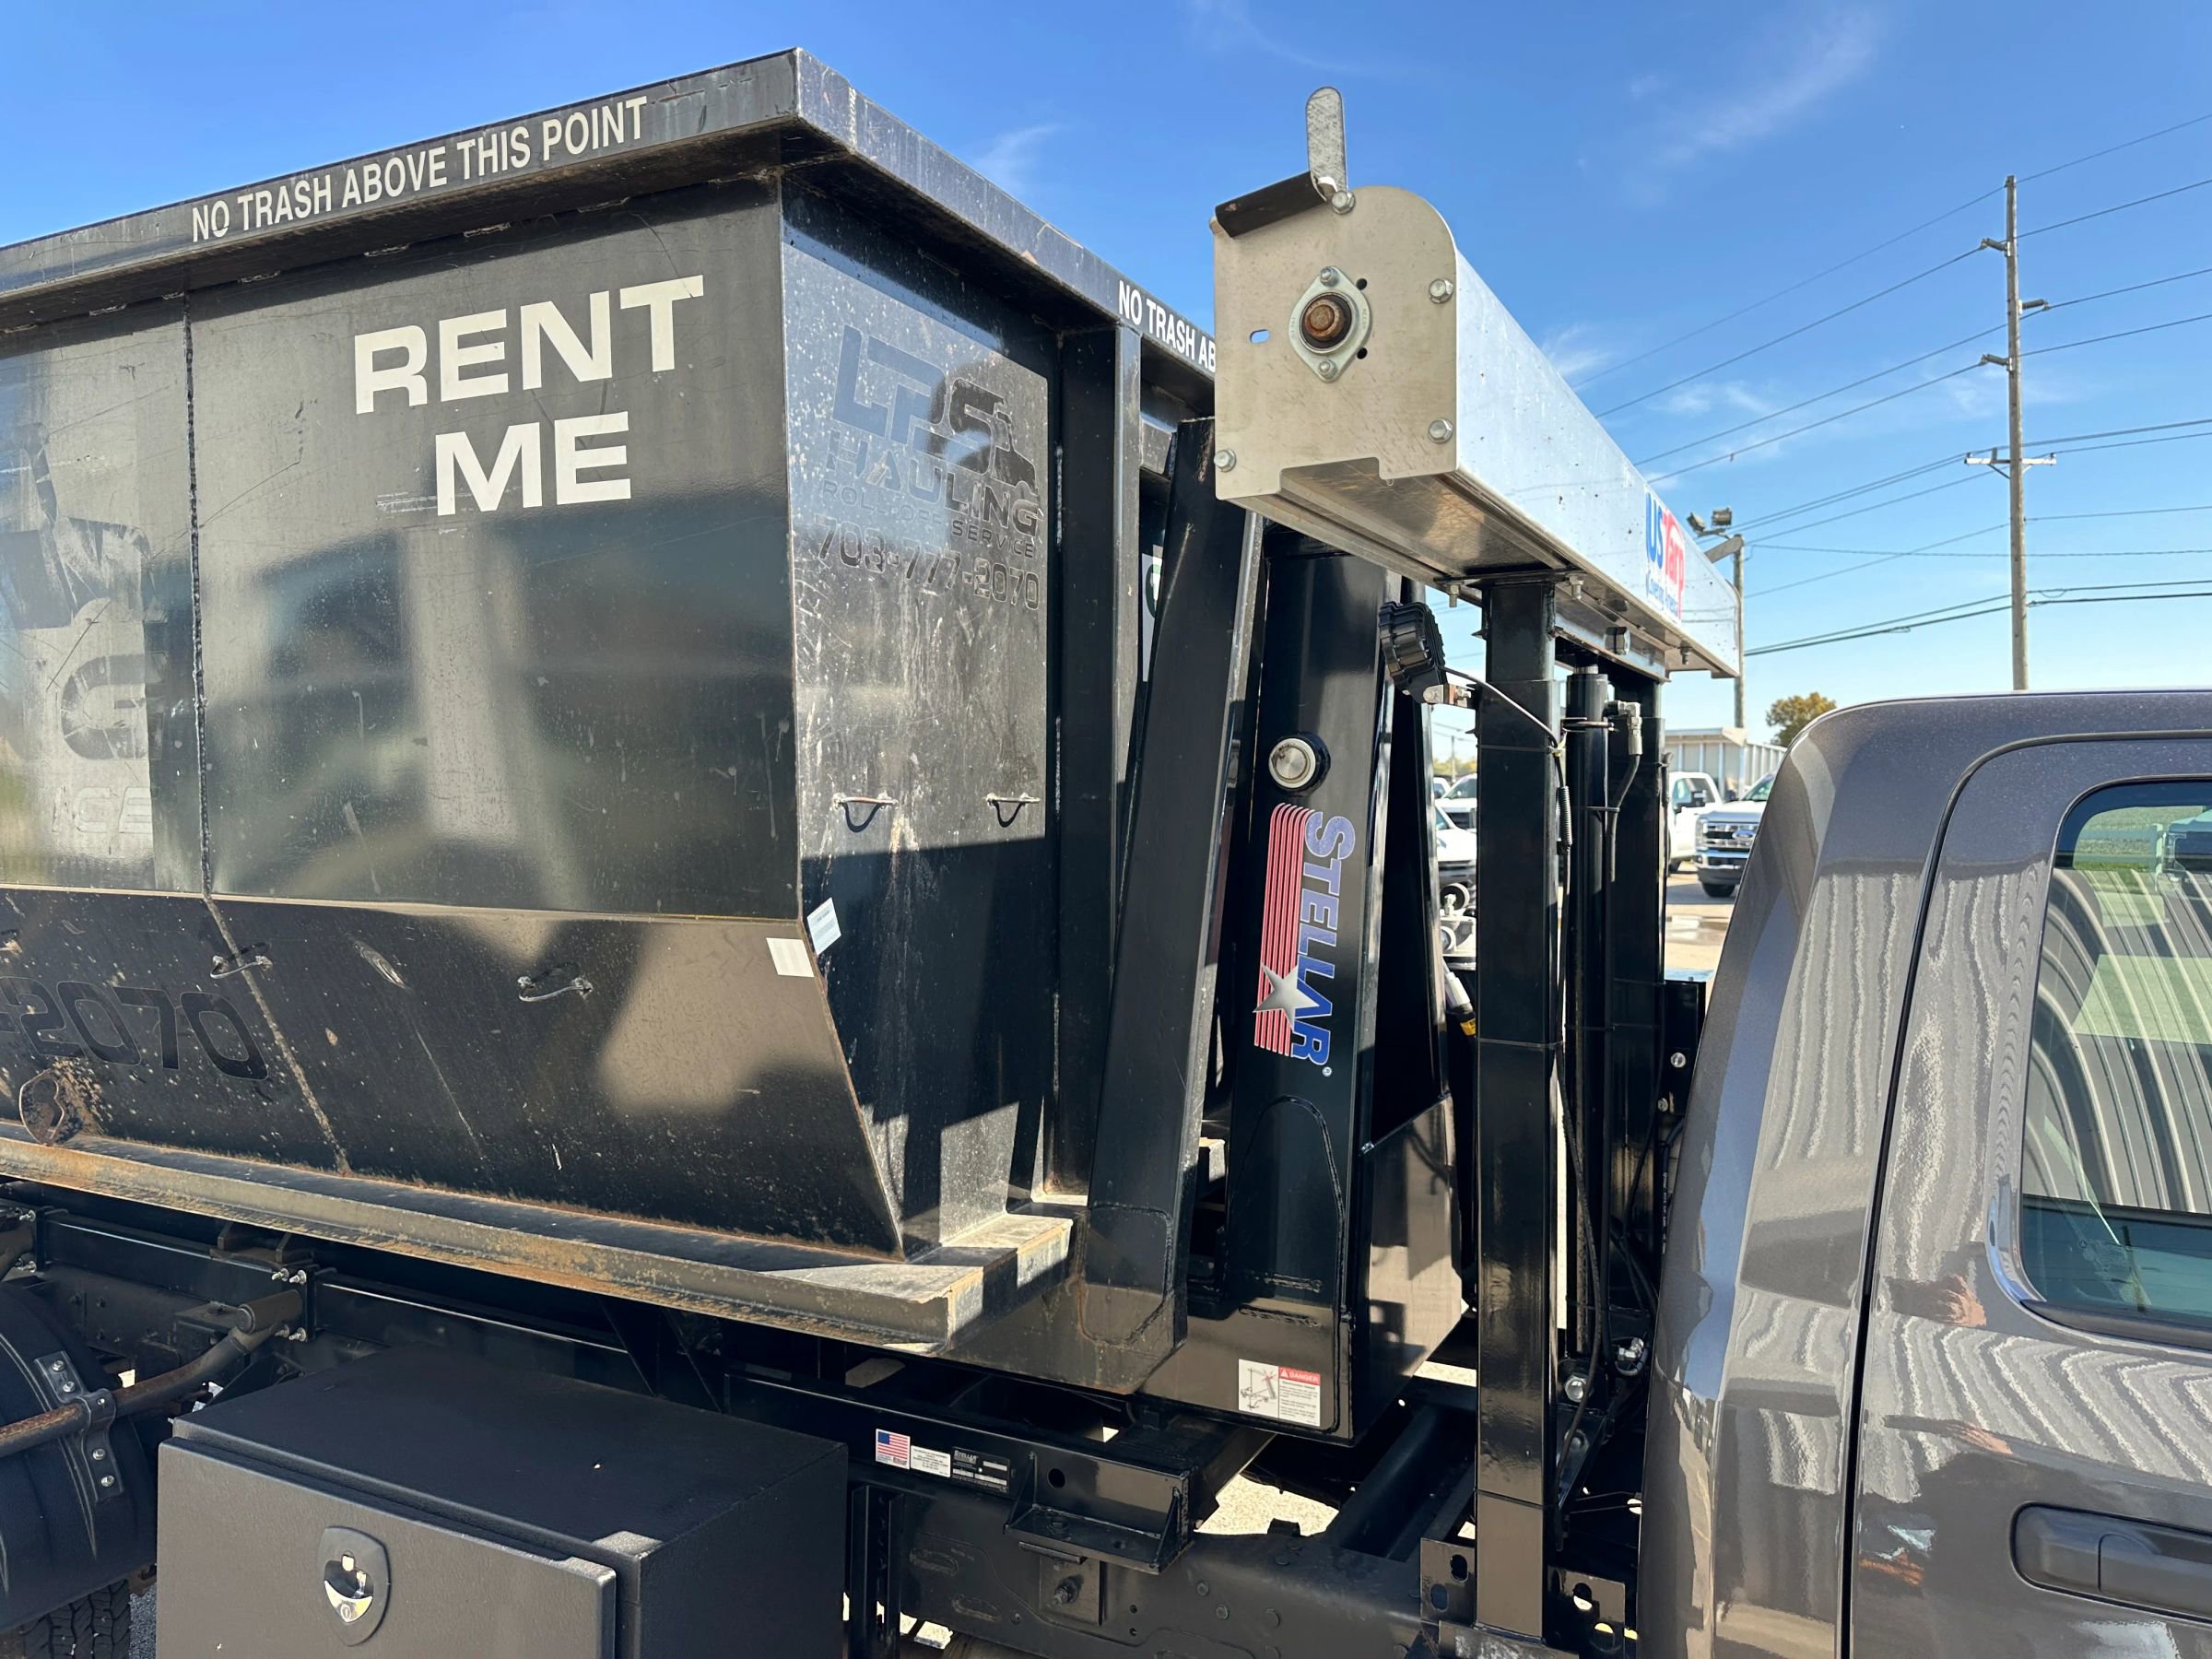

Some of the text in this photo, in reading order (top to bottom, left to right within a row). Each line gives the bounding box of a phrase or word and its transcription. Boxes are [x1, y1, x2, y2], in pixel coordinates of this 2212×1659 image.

[192, 95, 648, 242] NO TRASH ABOVE THIS POINT
[354, 275, 704, 415] RENT
[1118, 279, 1143, 325] NO
[1146, 298, 1195, 360] TRASH
[434, 410, 632, 517] ME
[825, 427, 1040, 538] HAULING
[813, 512, 1040, 611] 703-777-2070
[951, 518, 1034, 559] SERVICE
[1288, 1371, 1319, 1382] DANGER
